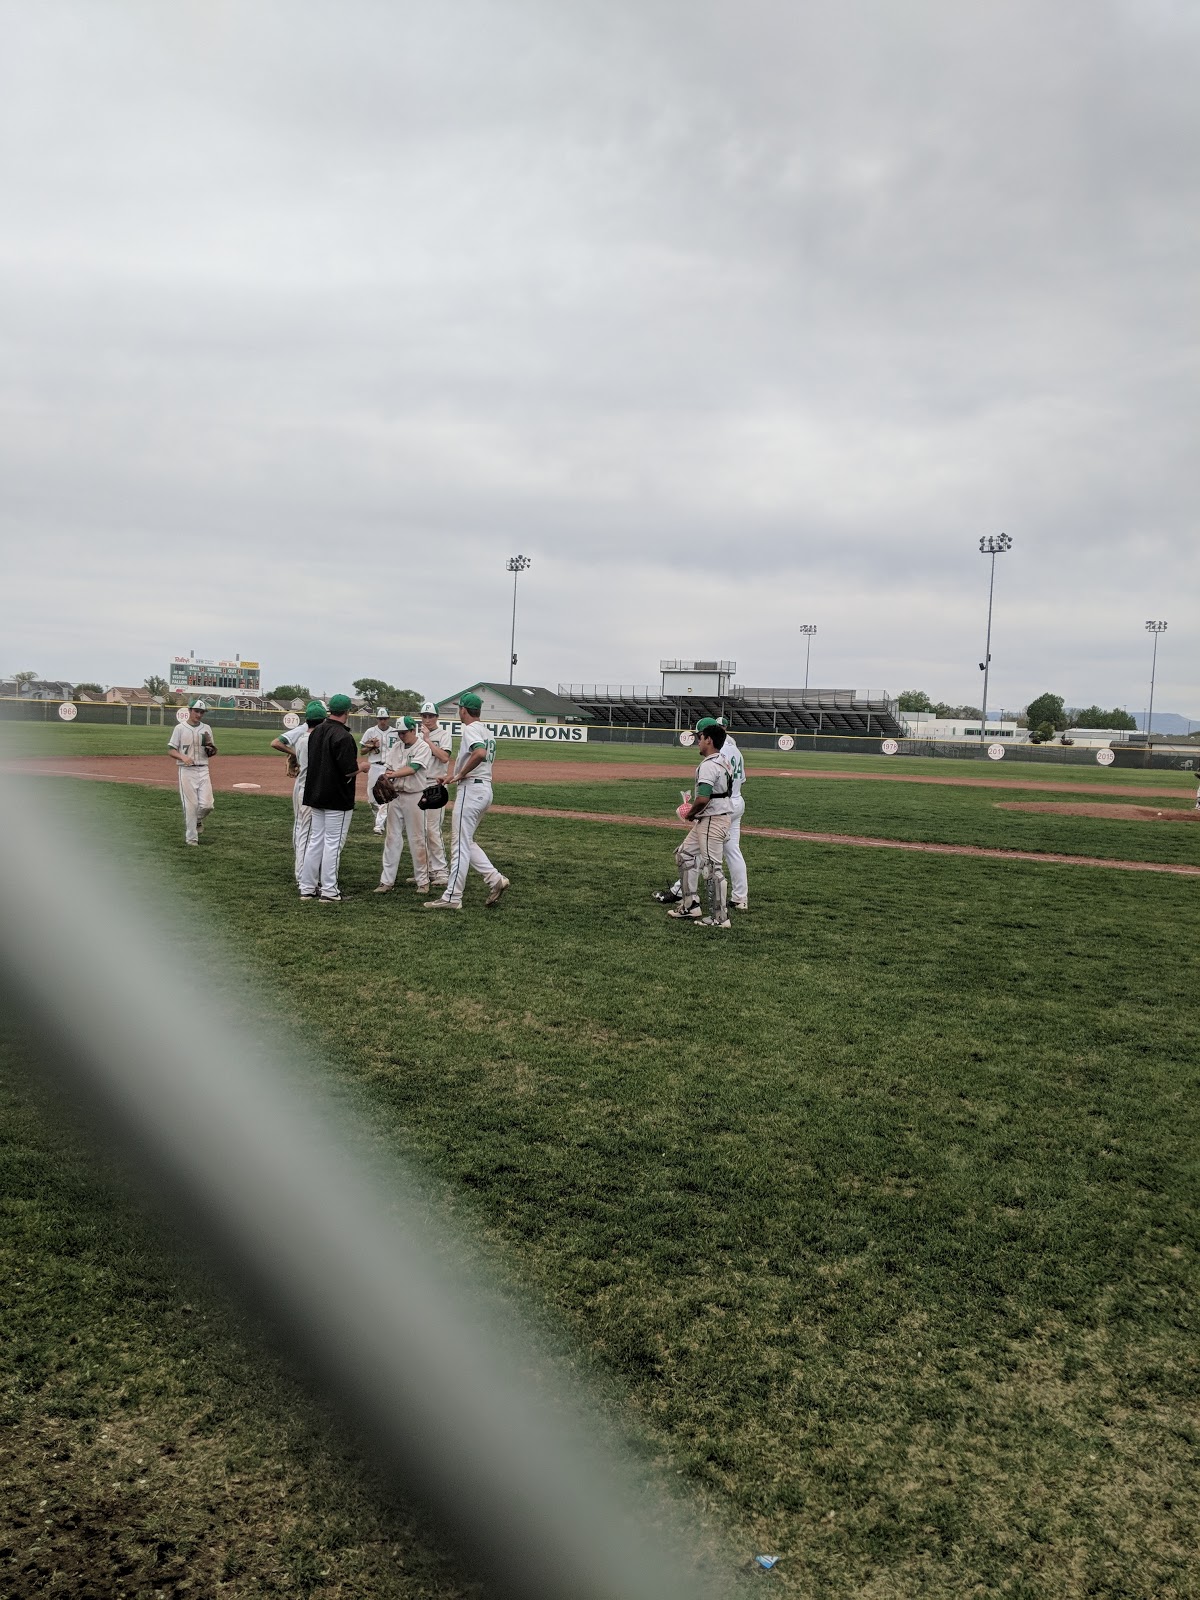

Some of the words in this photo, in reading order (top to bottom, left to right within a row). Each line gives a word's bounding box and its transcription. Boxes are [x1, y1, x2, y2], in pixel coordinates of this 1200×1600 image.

[177, 712, 189, 720] 196
[284, 717, 299, 725] 1971
[485, 724, 582, 740] HAMPIONS
[182, 744, 190, 755] 7
[988, 747, 1004, 755] 2011
[1097, 752, 1114, 760] 2015
[731, 755, 743, 780] 24
